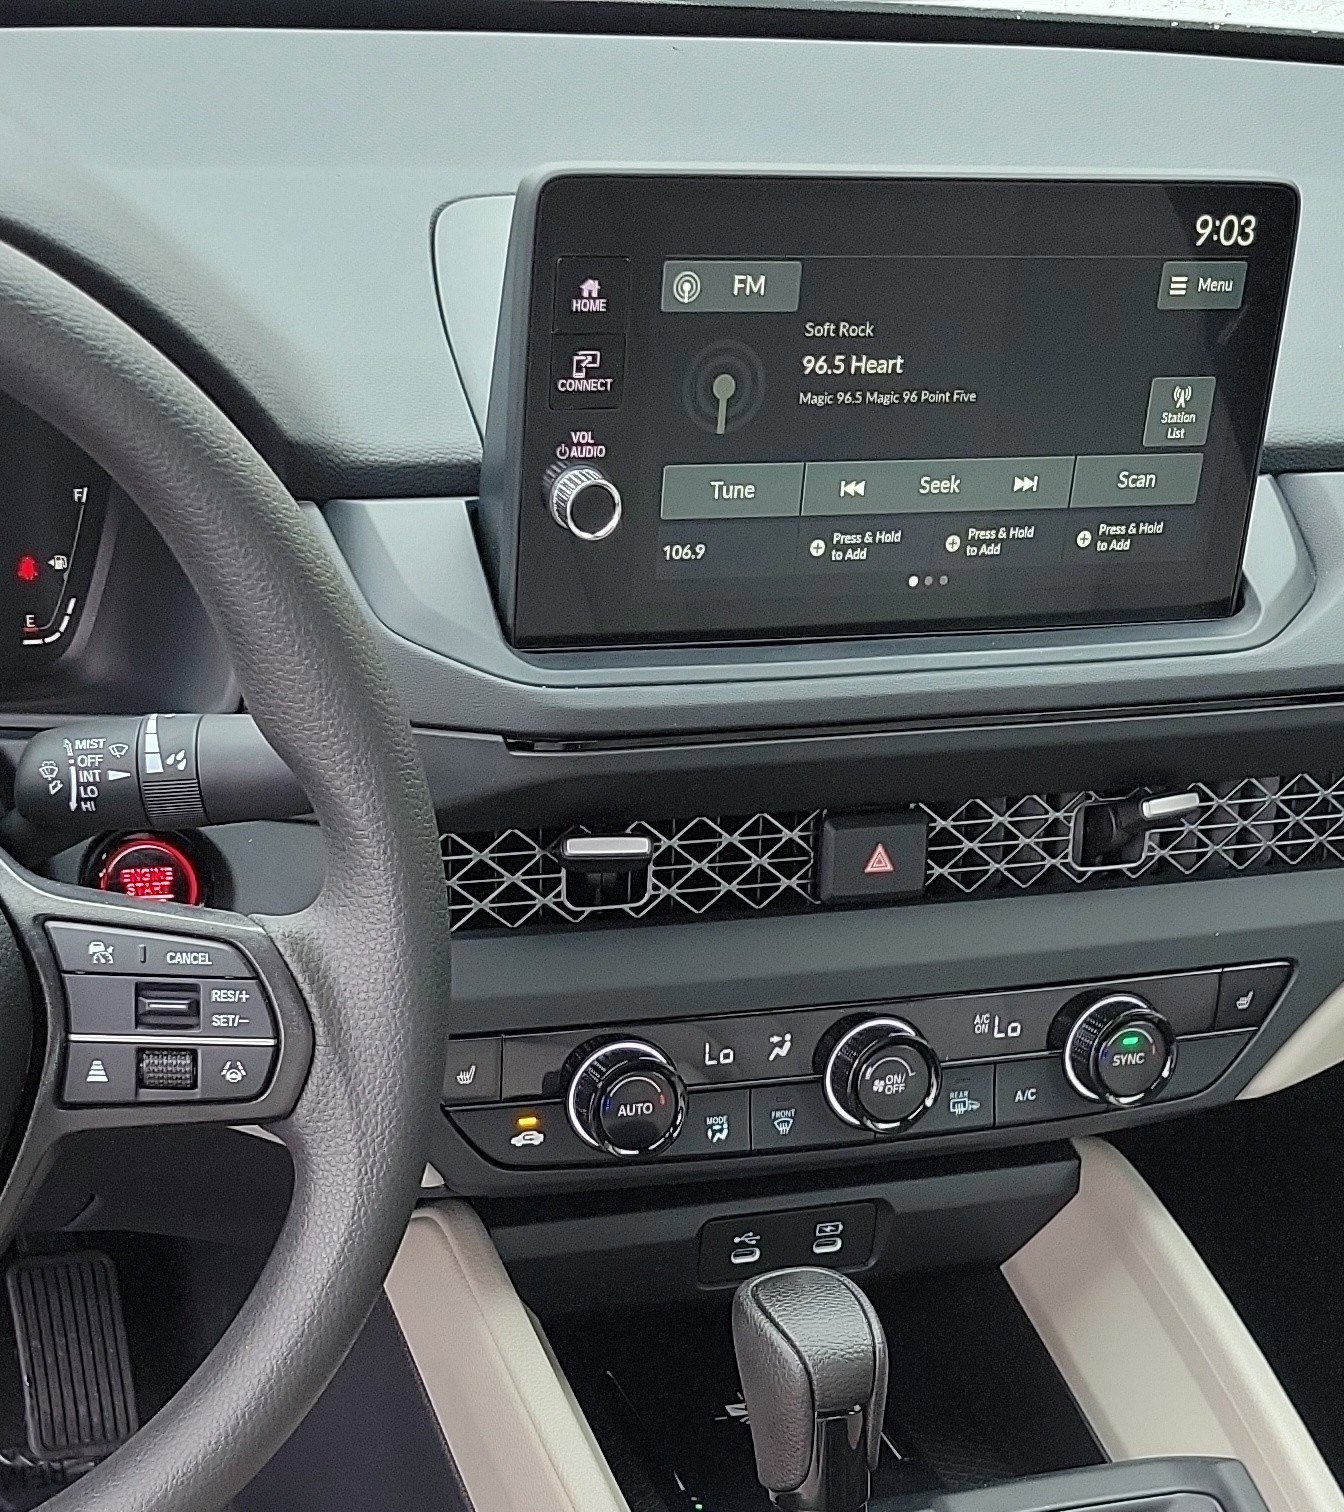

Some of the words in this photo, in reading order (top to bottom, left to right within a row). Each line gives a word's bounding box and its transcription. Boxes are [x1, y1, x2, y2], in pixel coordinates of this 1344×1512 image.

[1195, 215, 1256, 247] 9:03
[733, 275, 766, 296] FM
[1198, 278, 1233, 292] Menu
[572, 299, 607, 312] HOME
[805, 322, 836, 337] Soft
[839, 321, 874, 337] Rock
[802, 355, 845, 374] 96.5
[850, 355, 904, 374] Heart
[558, 379, 613, 392] CONNECT
[799, 392, 833, 406] Magic
[837, 391, 862, 404] 96.5
[866, 391, 899, 406] Magic
[902, 391, 918, 403] 96
[921, 390, 950, 403] Point
[953, 389, 977, 402] Five
[1161, 412, 1196, 424] Station
[570, 432, 594, 443] VOL
[1167, 427, 1185, 439] List
[570, 445, 606, 458] AUDIO
[919, 475, 960, 494] Seek
[1118, 472, 1156, 488] Scan
[710, 481, 755, 499] Tune
[968, 528, 996, 540] Press
[998, 527, 1007, 539] &
[1009, 526, 1035, 539] Hold
[1098, 524, 1126, 535] Press
[1128, 523, 1137, 534] &
[1139, 522, 1164, 534] Hold
[833, 532, 862, 544] Press
[864, 531, 873, 543] &
[876, 530, 902, 543] Hold
[966, 546, 977, 556] to
[979, 543, 1001, 556] Add
[1096, 541, 1107, 551] to
[1109, 539, 1131, 551] Add
[663, 544, 706, 560] 106.9
[831, 550, 843, 561] to
[845, 548, 867, 560] Add
[25, 615, 35, 628] E
[75, 738, 106, 750] MIST
[77, 755, 103, 767] OFF
[79, 770, 102, 782] INT
[80, 786, 98, 798] LO
[81, 801, 96, 811] HI
[121, 867, 173, 882] ENGINE
[126, 881, 170, 896] START
[166, 951, 212, 965] CANCEL
[212, 989, 250, 1003] RES/+
[974, 1013, 990, 1025] A/C
[975, 1024, 989, 1034] ON
[993, 1015, 1021, 1038] Lo
[704, 1042, 734, 1066] Lo
[1112, 1053, 1145, 1067] SYNC
[885, 1075, 906, 1085] ON/
[885, 1085, 906, 1094] OFF
[950, 1090, 969, 1099] REAR
[1014, 1088, 1037, 1102] A/C
[618, 1101, 654, 1118] AUTO
[771, 1108, 796, 1120] FRONT
[706, 1115, 729, 1126] MODE
